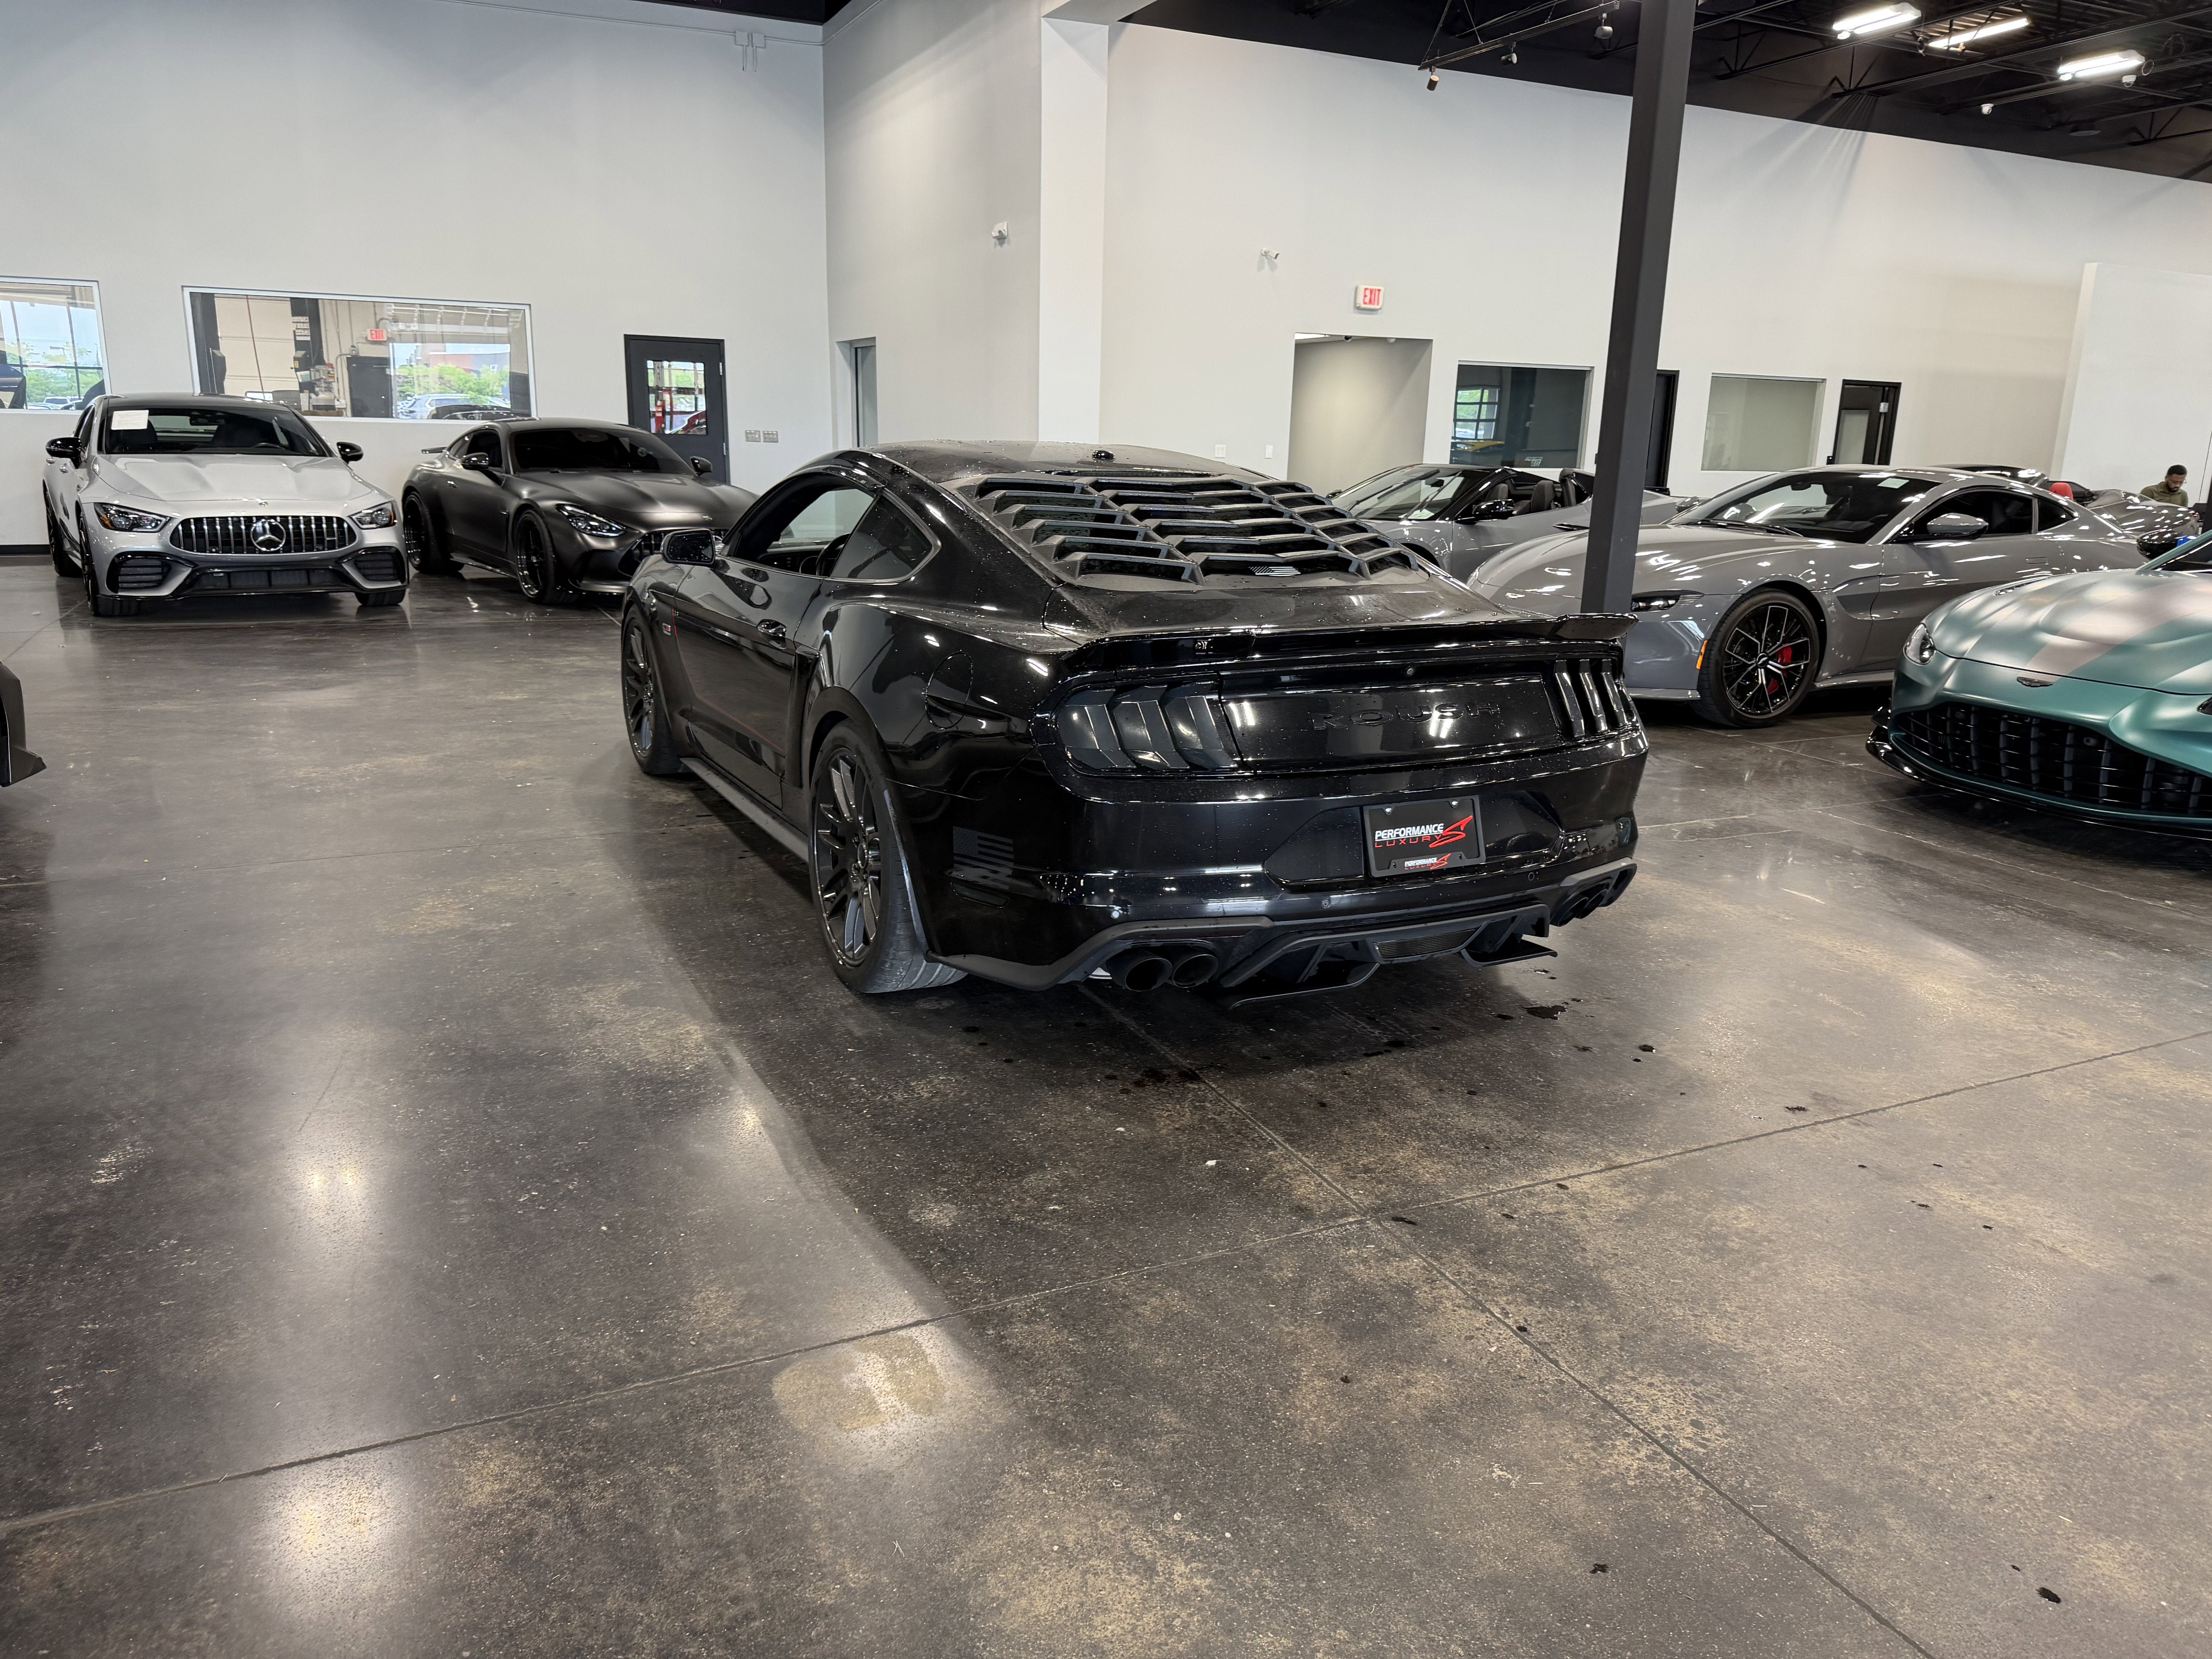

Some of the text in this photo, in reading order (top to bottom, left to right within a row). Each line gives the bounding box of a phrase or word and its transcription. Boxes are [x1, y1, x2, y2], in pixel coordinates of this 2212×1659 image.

[1363, 288, 1382, 306] EXIT
[370, 330, 384, 340] EXIT
[1307, 702, 1500, 731] ROUSH
[1375, 823, 1444, 840] PERFORMANCE
[1375, 835, 1442, 848] LUXURY
